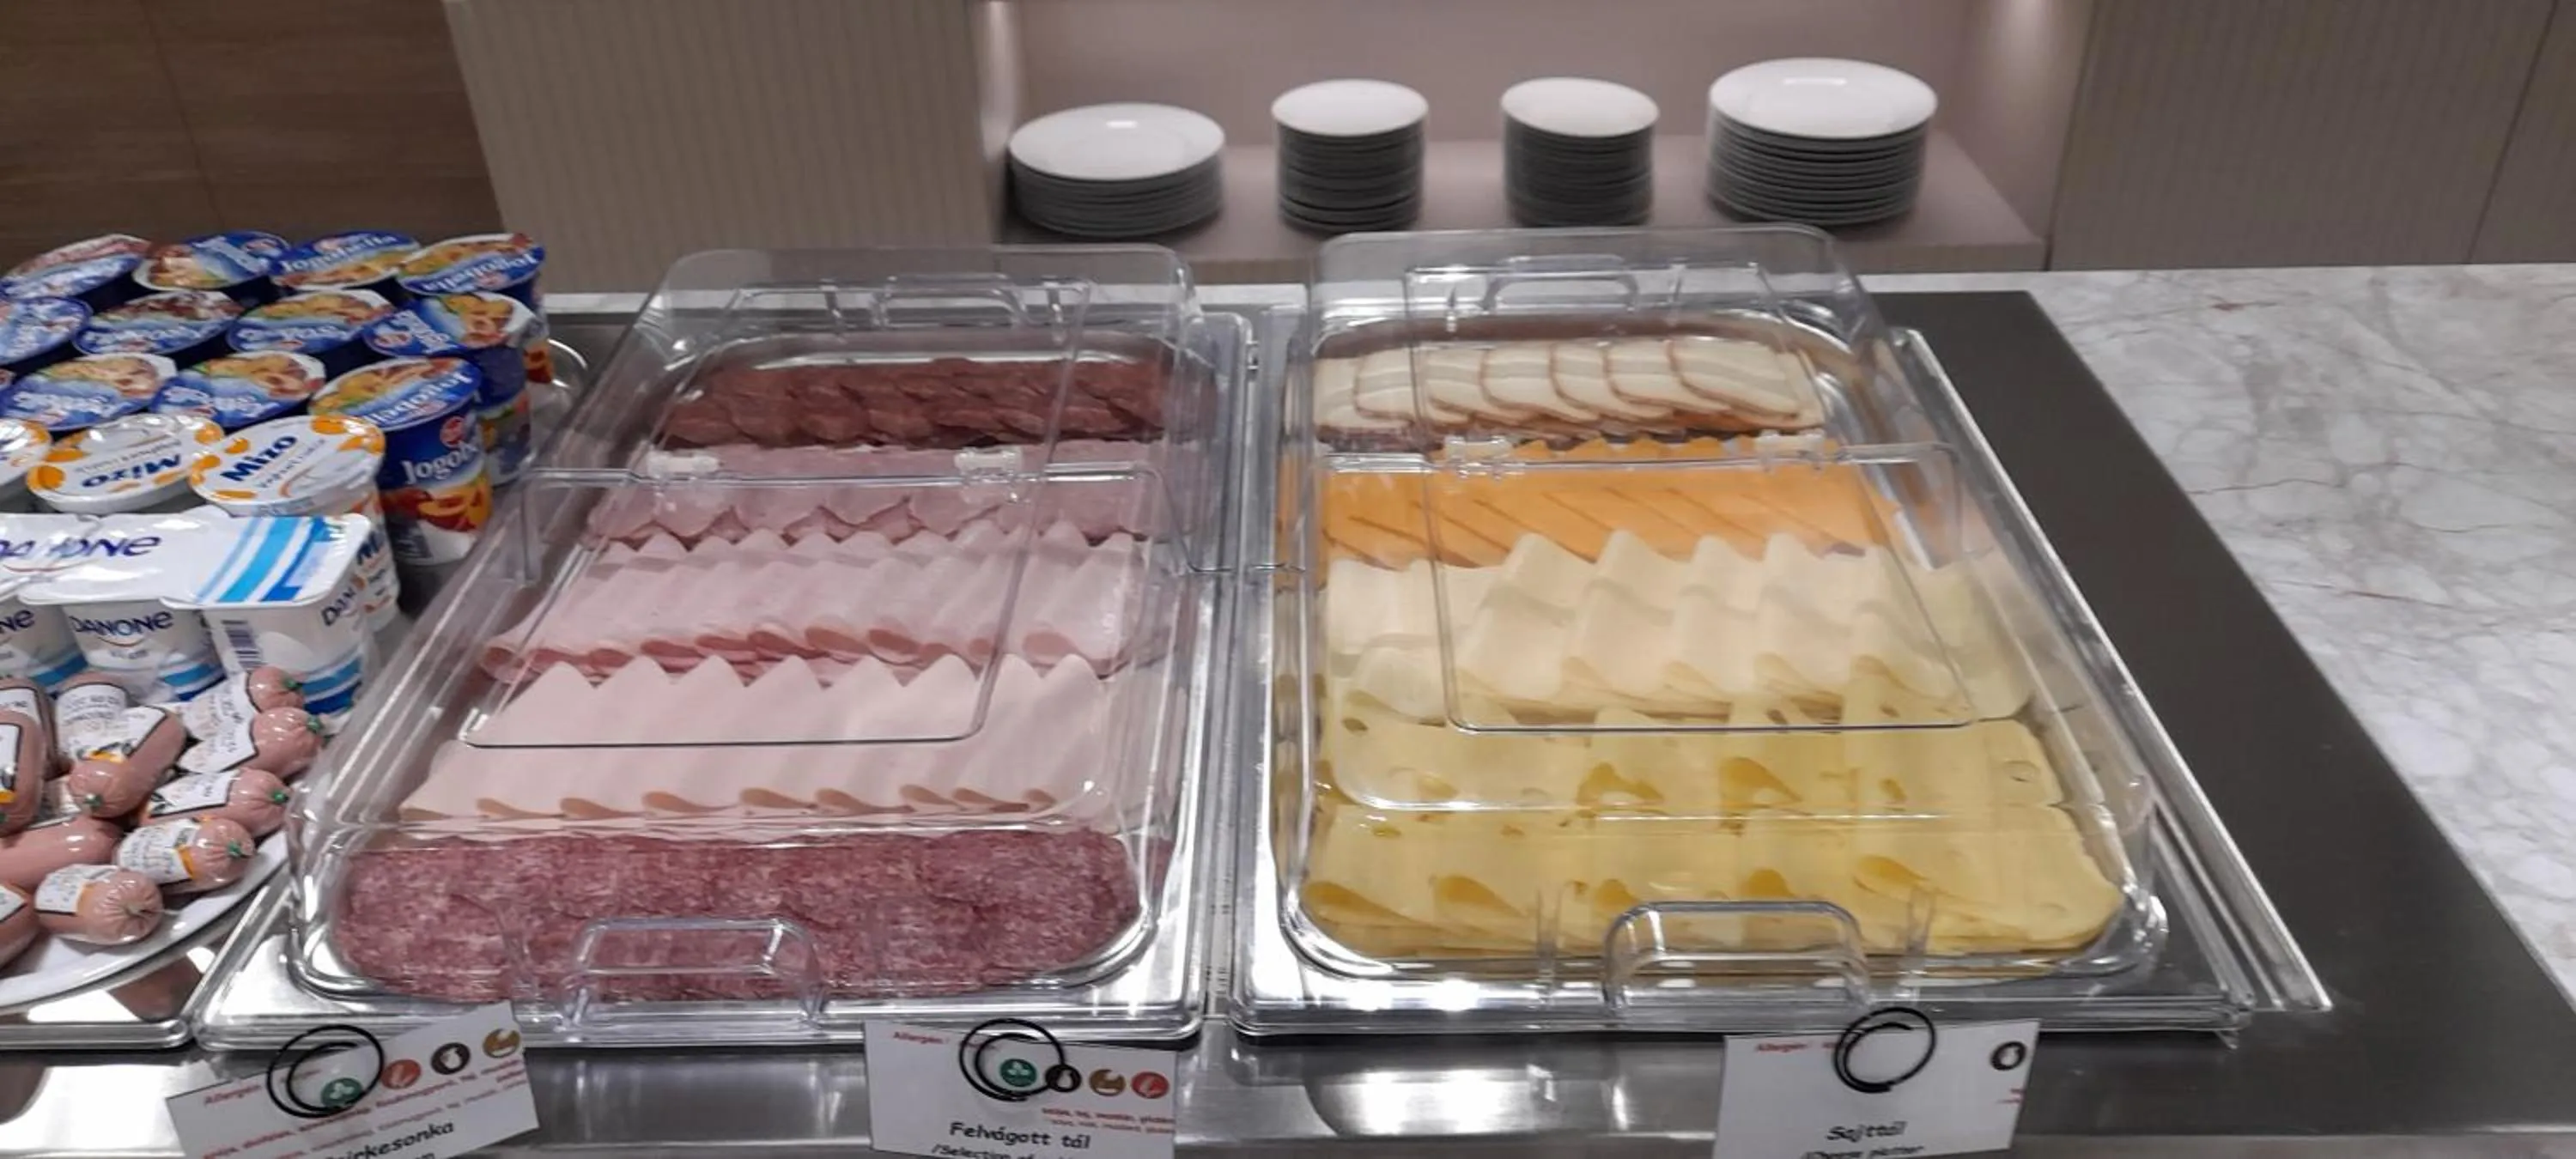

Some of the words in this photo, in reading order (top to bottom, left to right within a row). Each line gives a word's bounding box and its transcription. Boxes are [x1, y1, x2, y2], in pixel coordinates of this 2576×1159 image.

[221, 435, 297, 482] Mizo
[69, 610, 174, 636] DANONE
[950, 1121, 1051, 1146] Felvágott
[1061, 1134, 1091, 1149] tál
